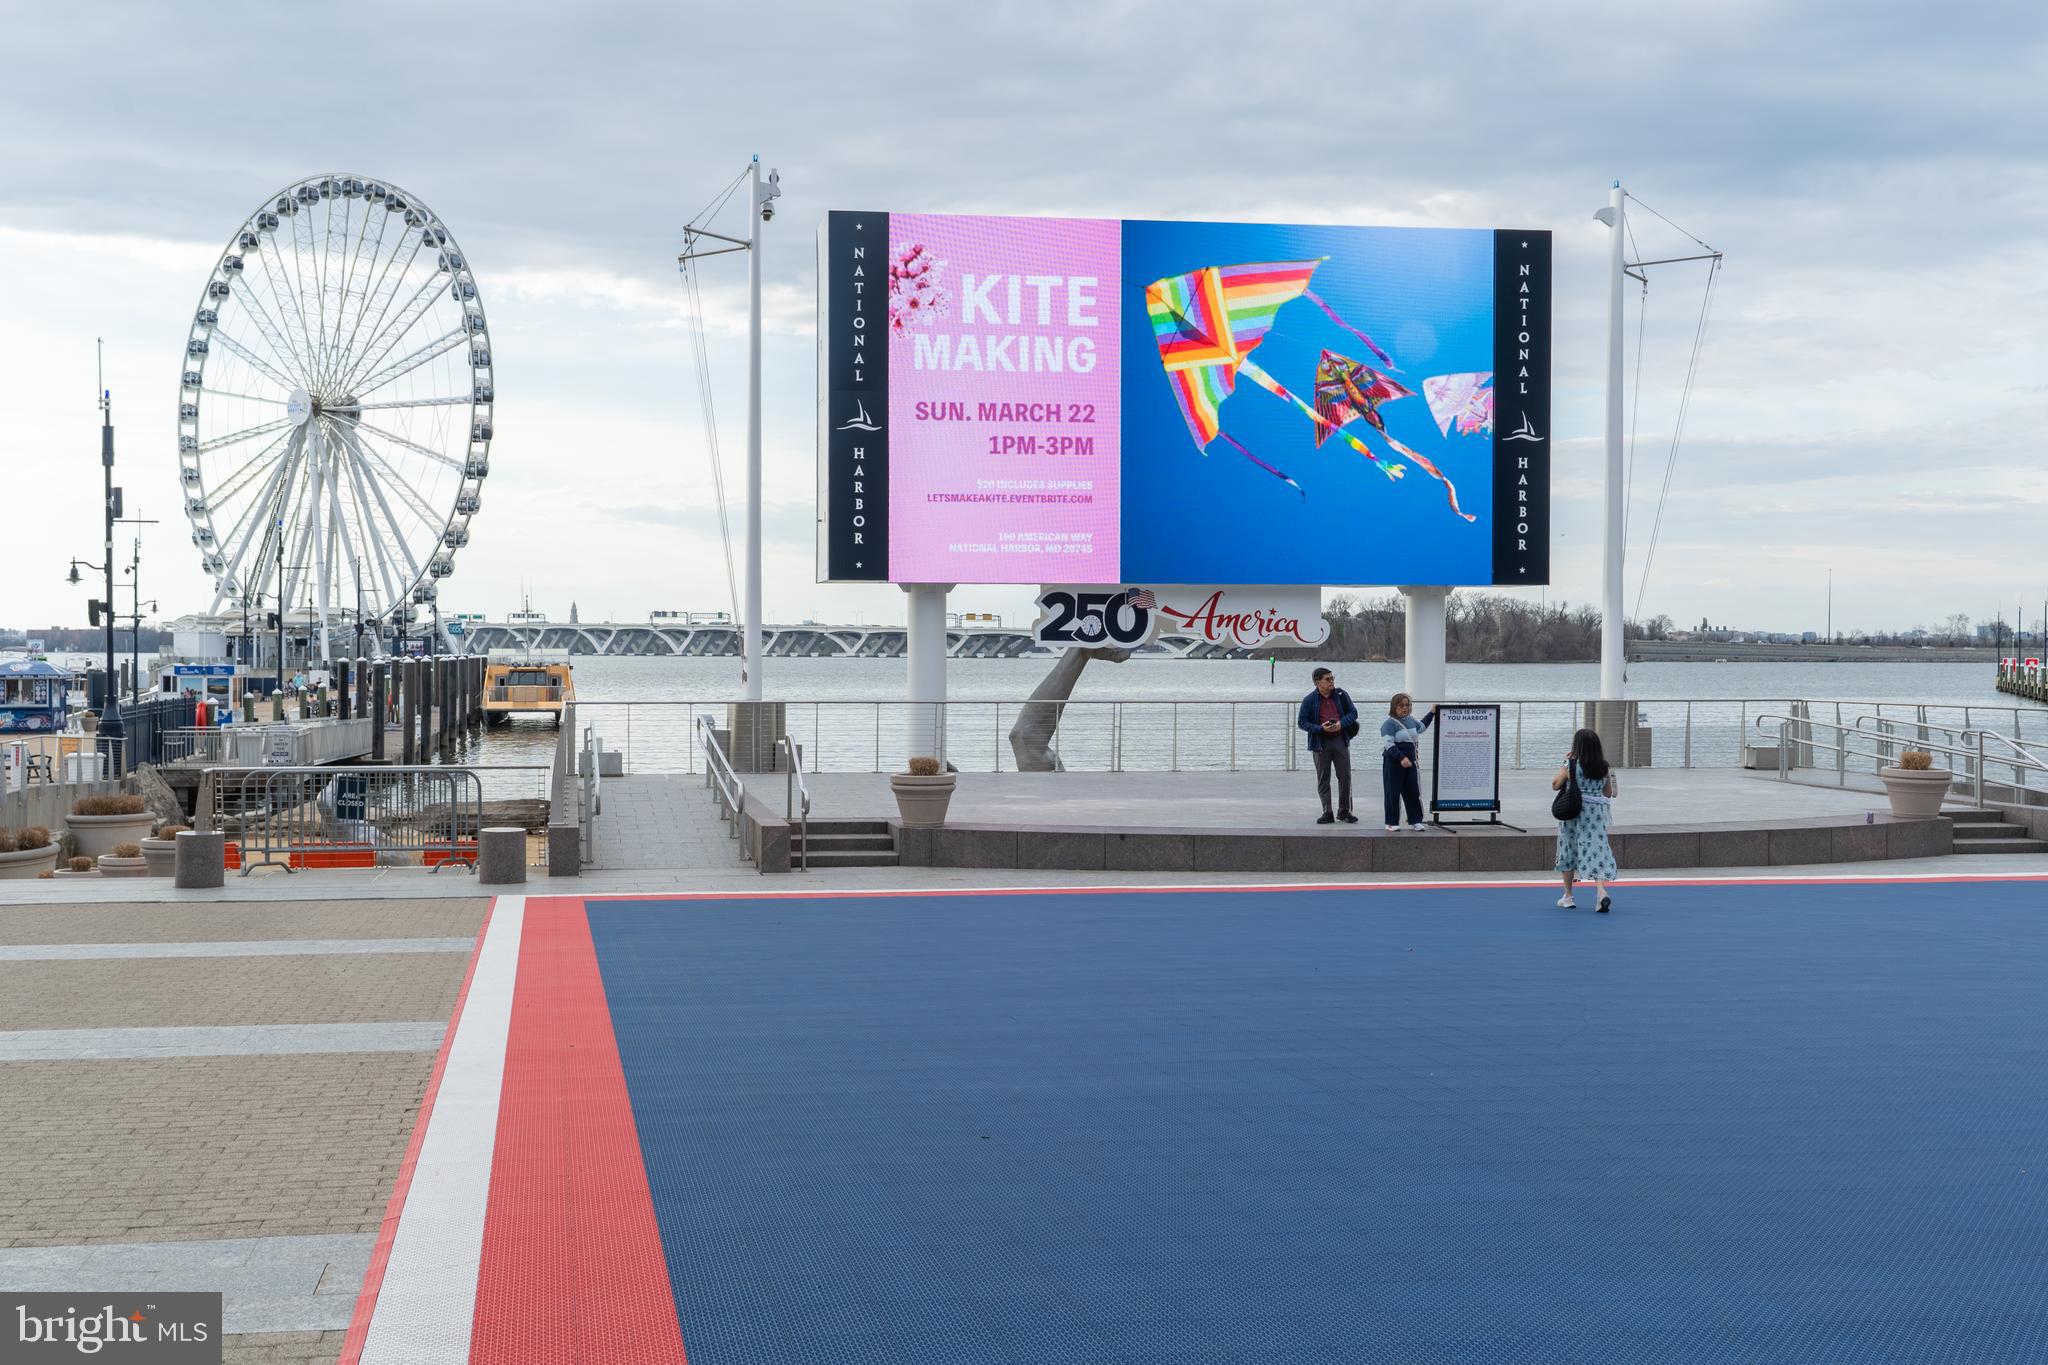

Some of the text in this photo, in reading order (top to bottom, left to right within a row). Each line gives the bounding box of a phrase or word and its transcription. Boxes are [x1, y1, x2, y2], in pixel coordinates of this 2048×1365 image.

[961, 273, 1099, 326] KITE
[914, 333, 1097, 373] MAKING
[853, 247, 865, 545] NATIONAL HARBOR
[915, 401, 1096, 423] SUN. MARCH 22
[1517, 264, 1530, 551] NATIONAL HARBOR
[989, 436, 1094, 455] 1PM-3PM
[996, 479, 1045, 490] INCLUDES
[1047, 480, 1093, 490] SUPPLIES
[927, 493, 1093, 504] LETSMAKEAKITE.EVENTBRITE.COM
[1018, 532, 1068, 542] AMERICAN
[1071, 532, 1093, 542] WAY
[949, 543, 997, 554] NATIONAL
[1040, 591, 1324, 646] 250 America
